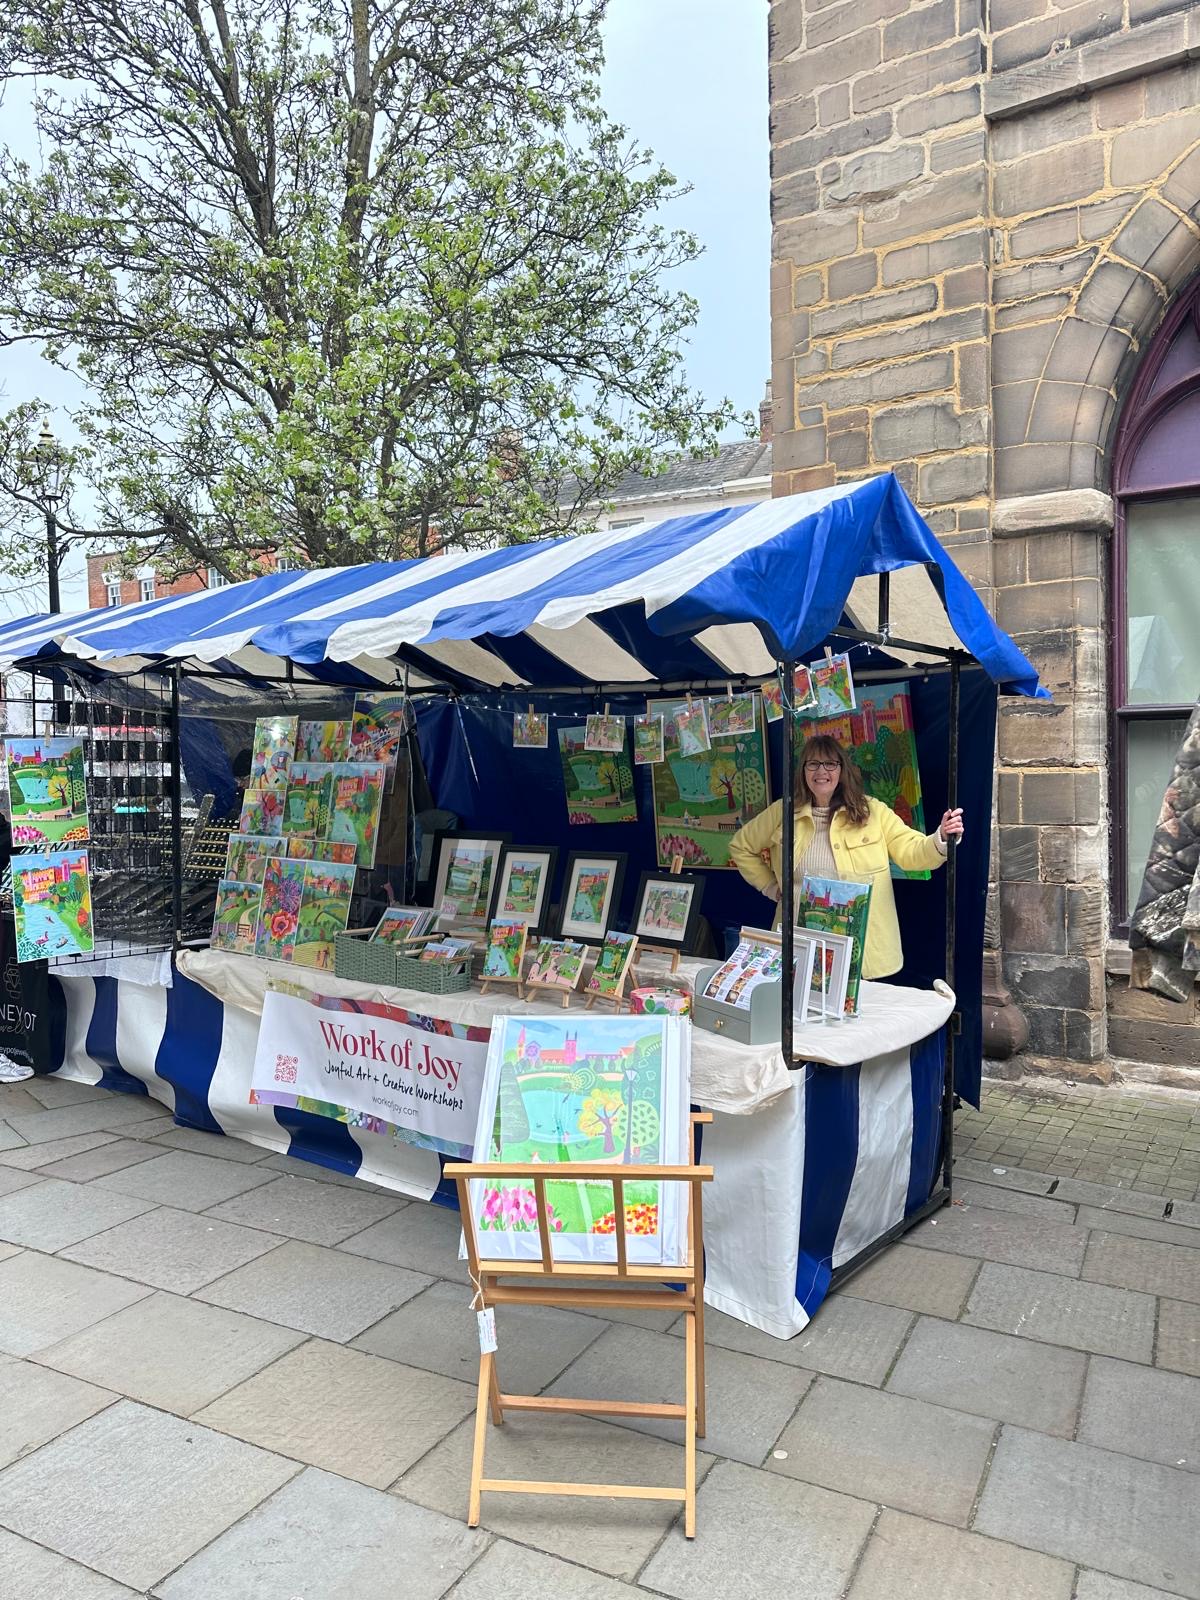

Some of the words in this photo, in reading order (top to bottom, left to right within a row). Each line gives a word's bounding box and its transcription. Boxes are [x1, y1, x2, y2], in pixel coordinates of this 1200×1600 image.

[318, 1020, 388, 1063] Work
[390, 1038, 413, 1071] of
[417, 1044, 463, 1091] Joy
[324, 1060, 354, 1080] Joyful
[356, 1064, 372, 1081] Art
[373, 1075, 380, 1084] +
[382, 1073, 414, 1096] Creative
[415, 1082, 464, 1112] Workshops
